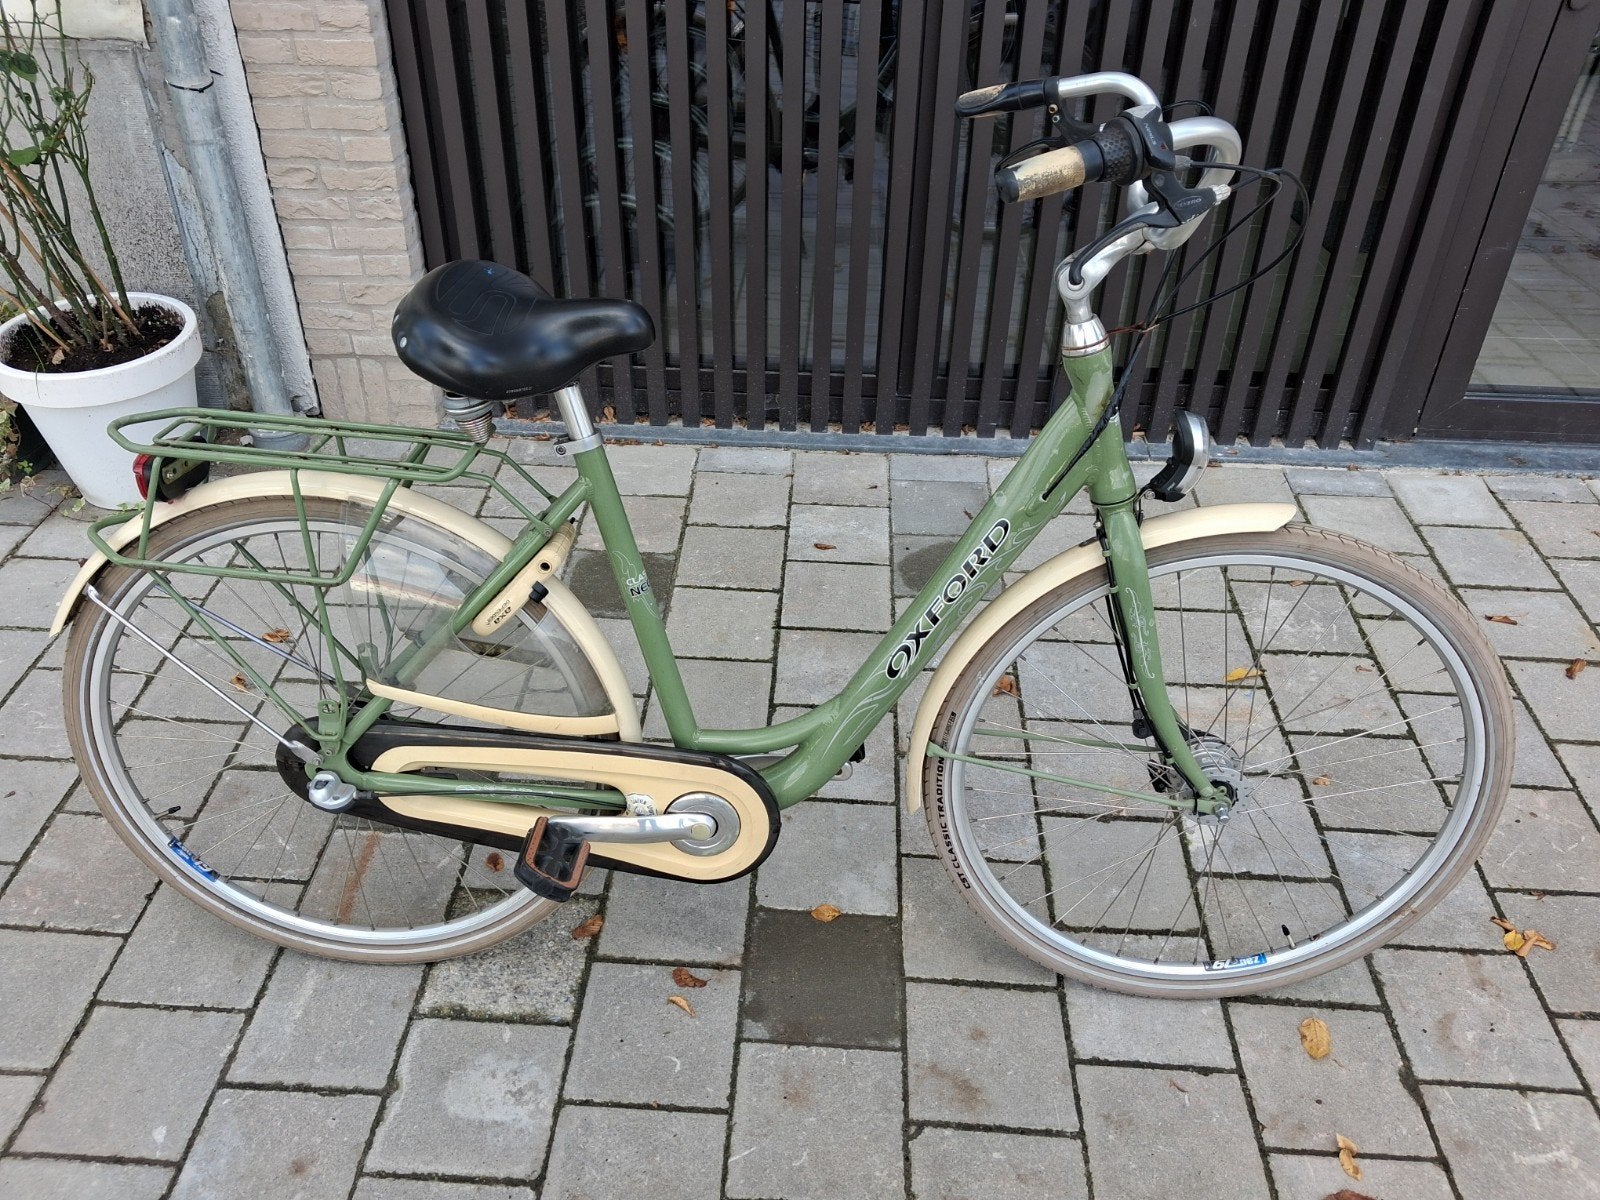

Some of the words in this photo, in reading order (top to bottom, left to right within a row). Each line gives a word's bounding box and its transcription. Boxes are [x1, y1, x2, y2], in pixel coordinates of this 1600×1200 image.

[886, 518, 1011, 680] OXFORD
[936, 756, 945, 819] TRADITION
[940, 822, 961, 869] CLASSIC
